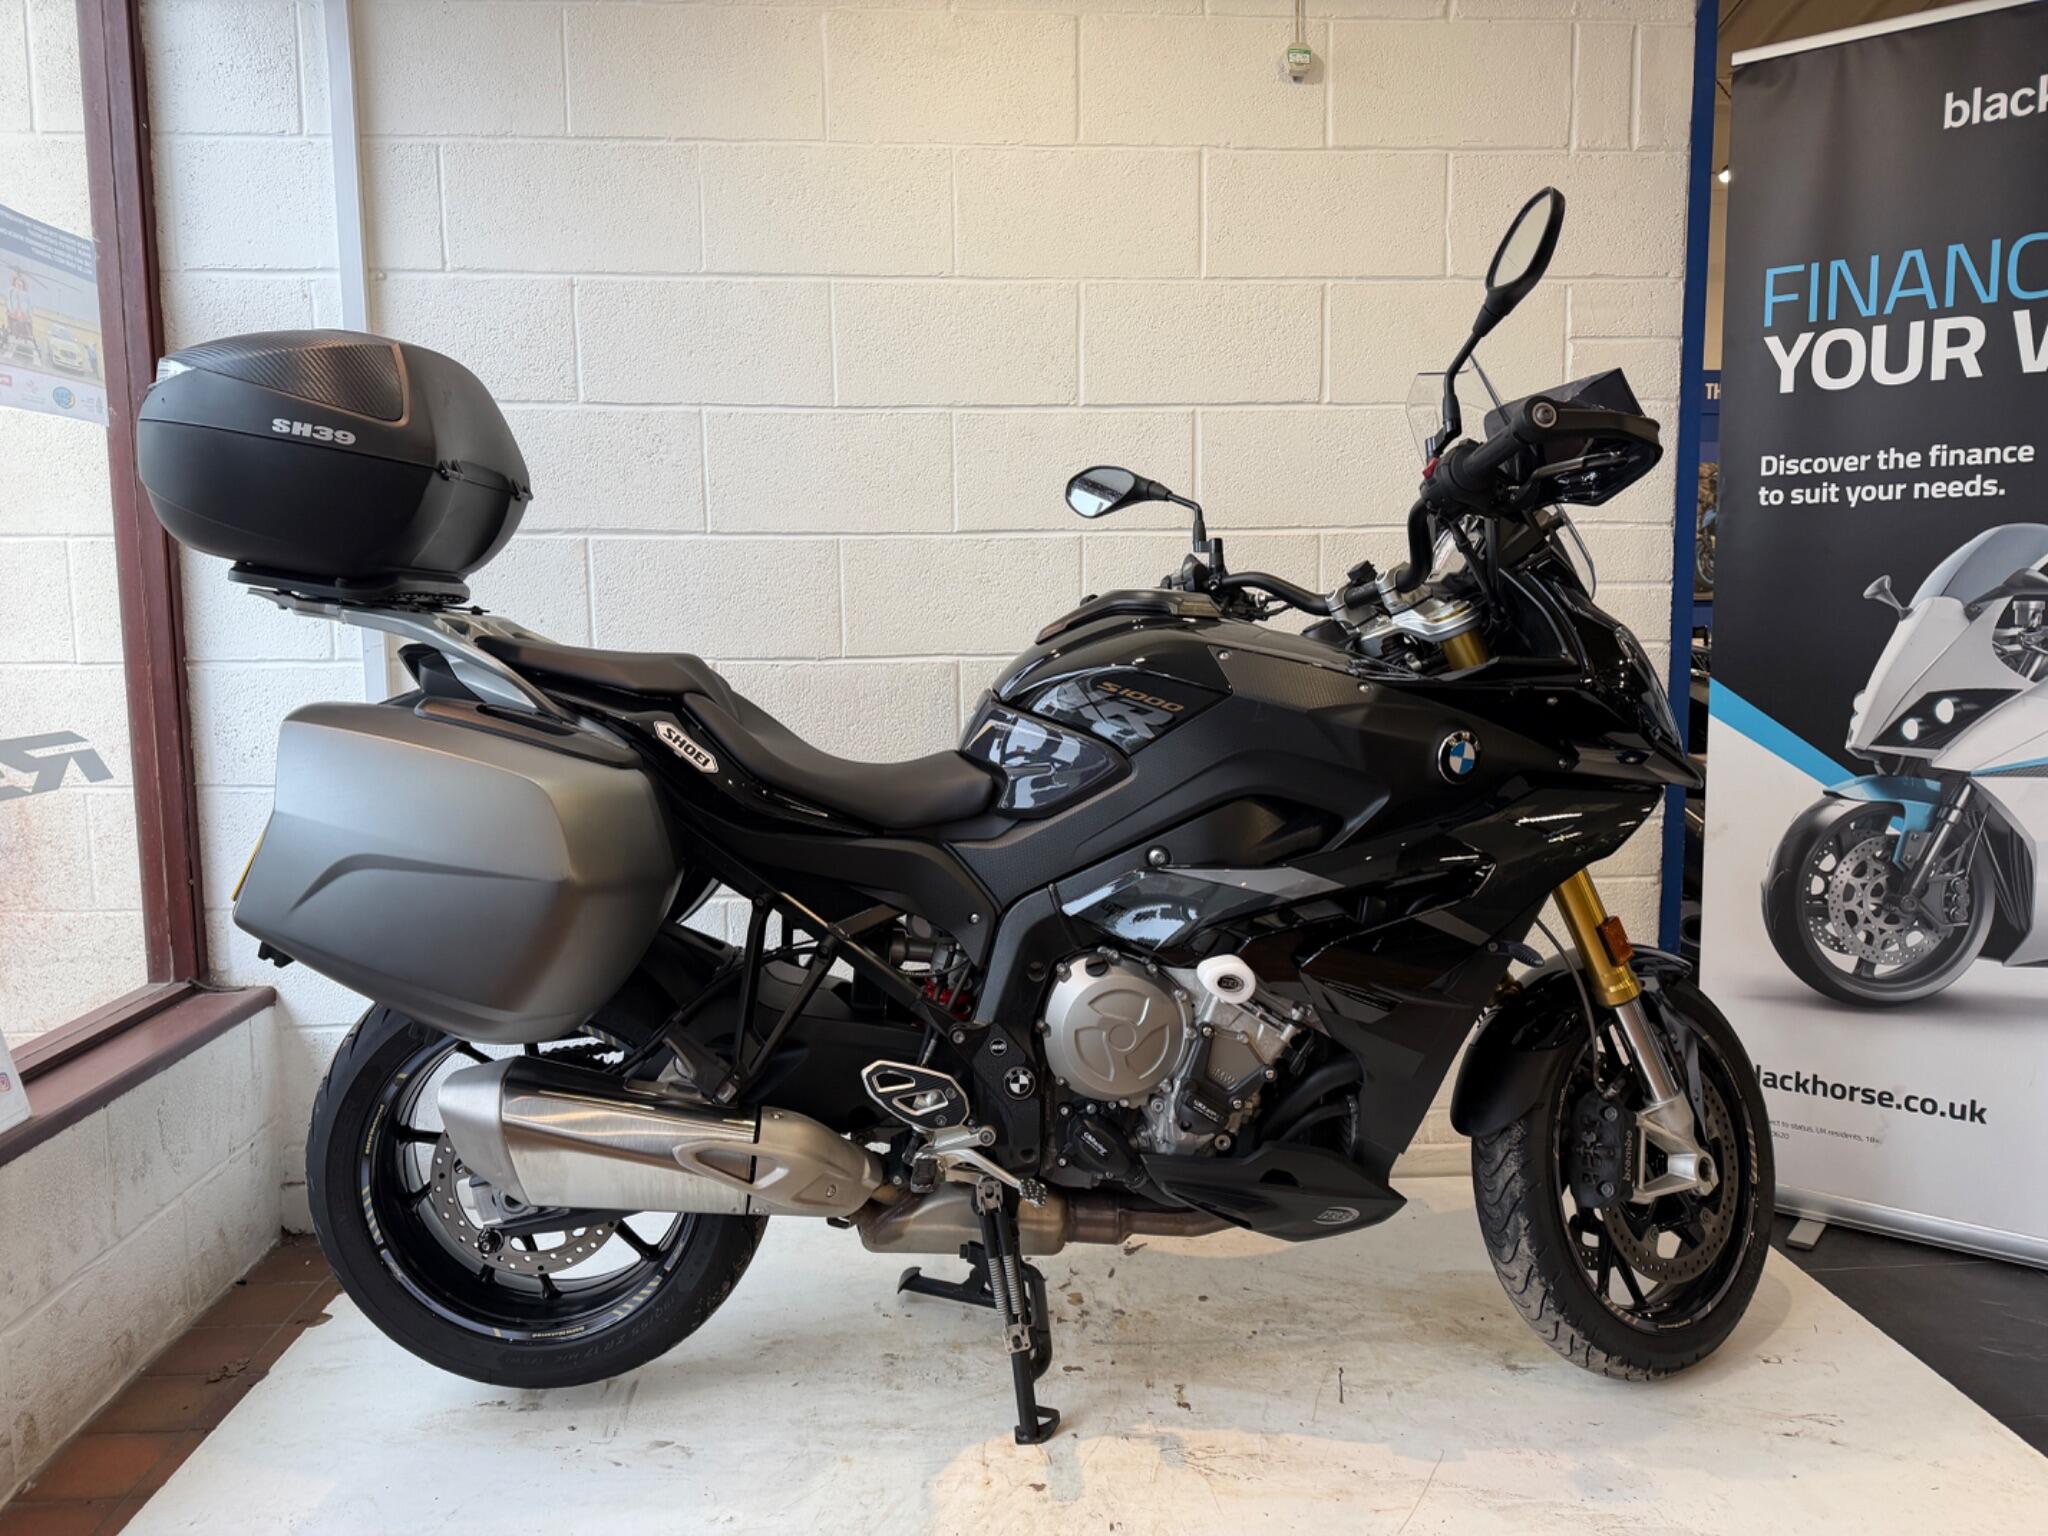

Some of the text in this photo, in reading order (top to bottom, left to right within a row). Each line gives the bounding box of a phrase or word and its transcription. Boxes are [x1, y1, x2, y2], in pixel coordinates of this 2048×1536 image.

[1763, 315, 1986, 393] YOUR
[271, 418, 356, 445] SH39
[1760, 443, 2035, 476] Discover the finance
[1758, 474, 2006, 508] to suit your needs.
[1096, 681, 1185, 712] S1000
[663, 727, 711, 768] SHOEI
